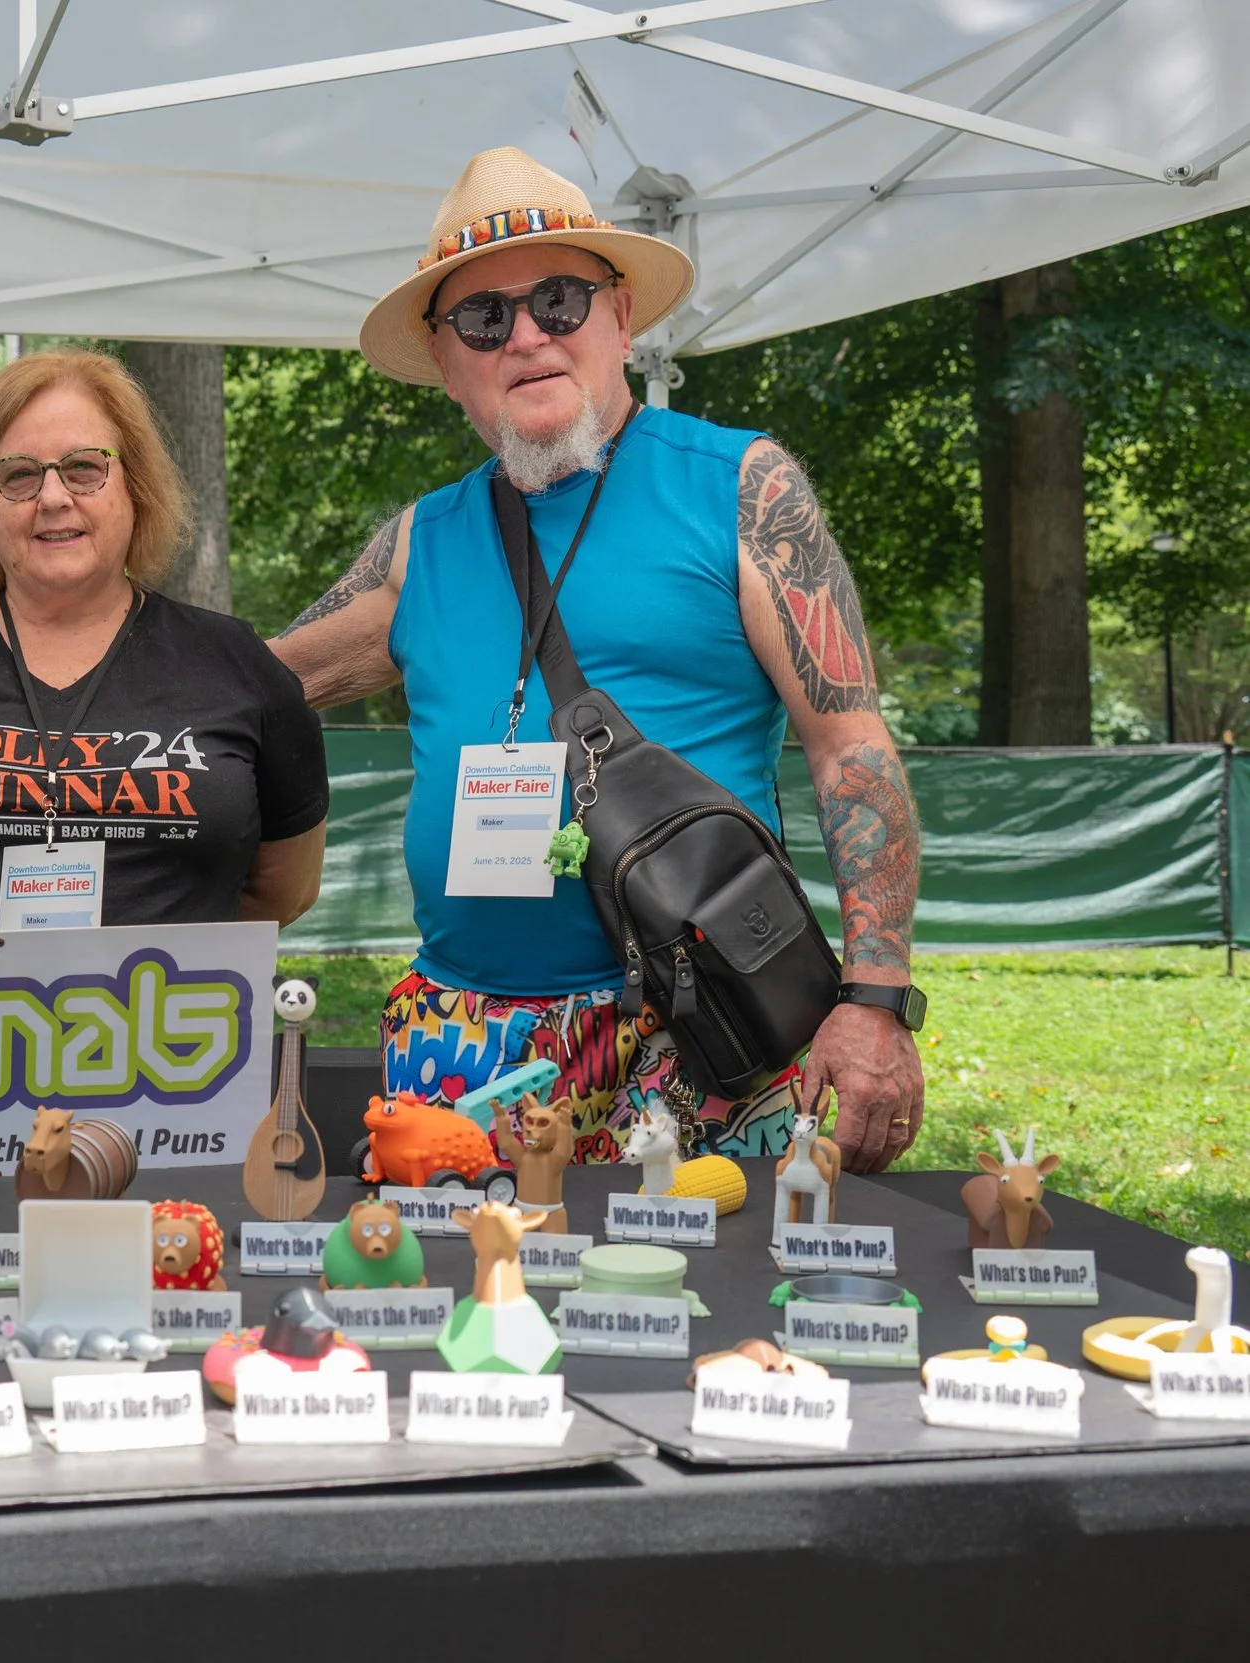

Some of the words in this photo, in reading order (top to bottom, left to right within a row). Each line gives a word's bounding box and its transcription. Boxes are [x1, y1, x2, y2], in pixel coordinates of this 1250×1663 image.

[465, 765, 508, 775] Downtown
[510, 764, 551, 773] Columbia
[467, 780, 511, 794] Maker
[515, 779, 550, 793] Faire
[481, 818, 504, 826] Maker
[62, 825, 100, 838] BABY
[104, 826, 145, 839] BIRDS
[8, 865, 49, 875] Downtown
[51, 862, 91, 872] Columbia
[472, 856, 492, 866] June
[510, 856, 532, 865] 2025
[11, 879, 53, 894] Maker
[57, 878, 90, 892] Faire
[26, 917, 48, 925] Maker
[386, 1019, 506, 1099] WOW
[151, 1128, 226, 1156] Puns
[387, 1200, 424, 1218] hat's
[427, 1201, 446, 1218] the
[613, 1206, 653, 1226] What's
[656, 1209, 675, 1228] the
[678, 1211, 709, 1230] Pun?
[246, 1237, 289, 1257] What's
[292, 1238, 313, 1256] the
[786, 1237, 829, 1257] What's
[831, 1238, 852, 1257] the
[854, 1240, 887, 1259] Pun?
[528, 1248, 549, 1266] the
[979, 1263, 1026, 1284] What's
[1028, 1263, 1051, 1284] the
[1054, 1264, 1087, 1284] Pun?
[169, 1307, 192, 1328] the
[196, 1307, 232, 1329] Pun?
[383, 1306, 406, 1326] the
[410, 1304, 445, 1325] Pun?
[565, 1308, 614, 1331] What's
[617, 1310, 640, 1332] the
[643, 1313, 680, 1334] Pun?
[792, 1318, 842, 1340] What's
[845, 1321, 869, 1342] the
[872, 1323, 908, 1344] Pun?
